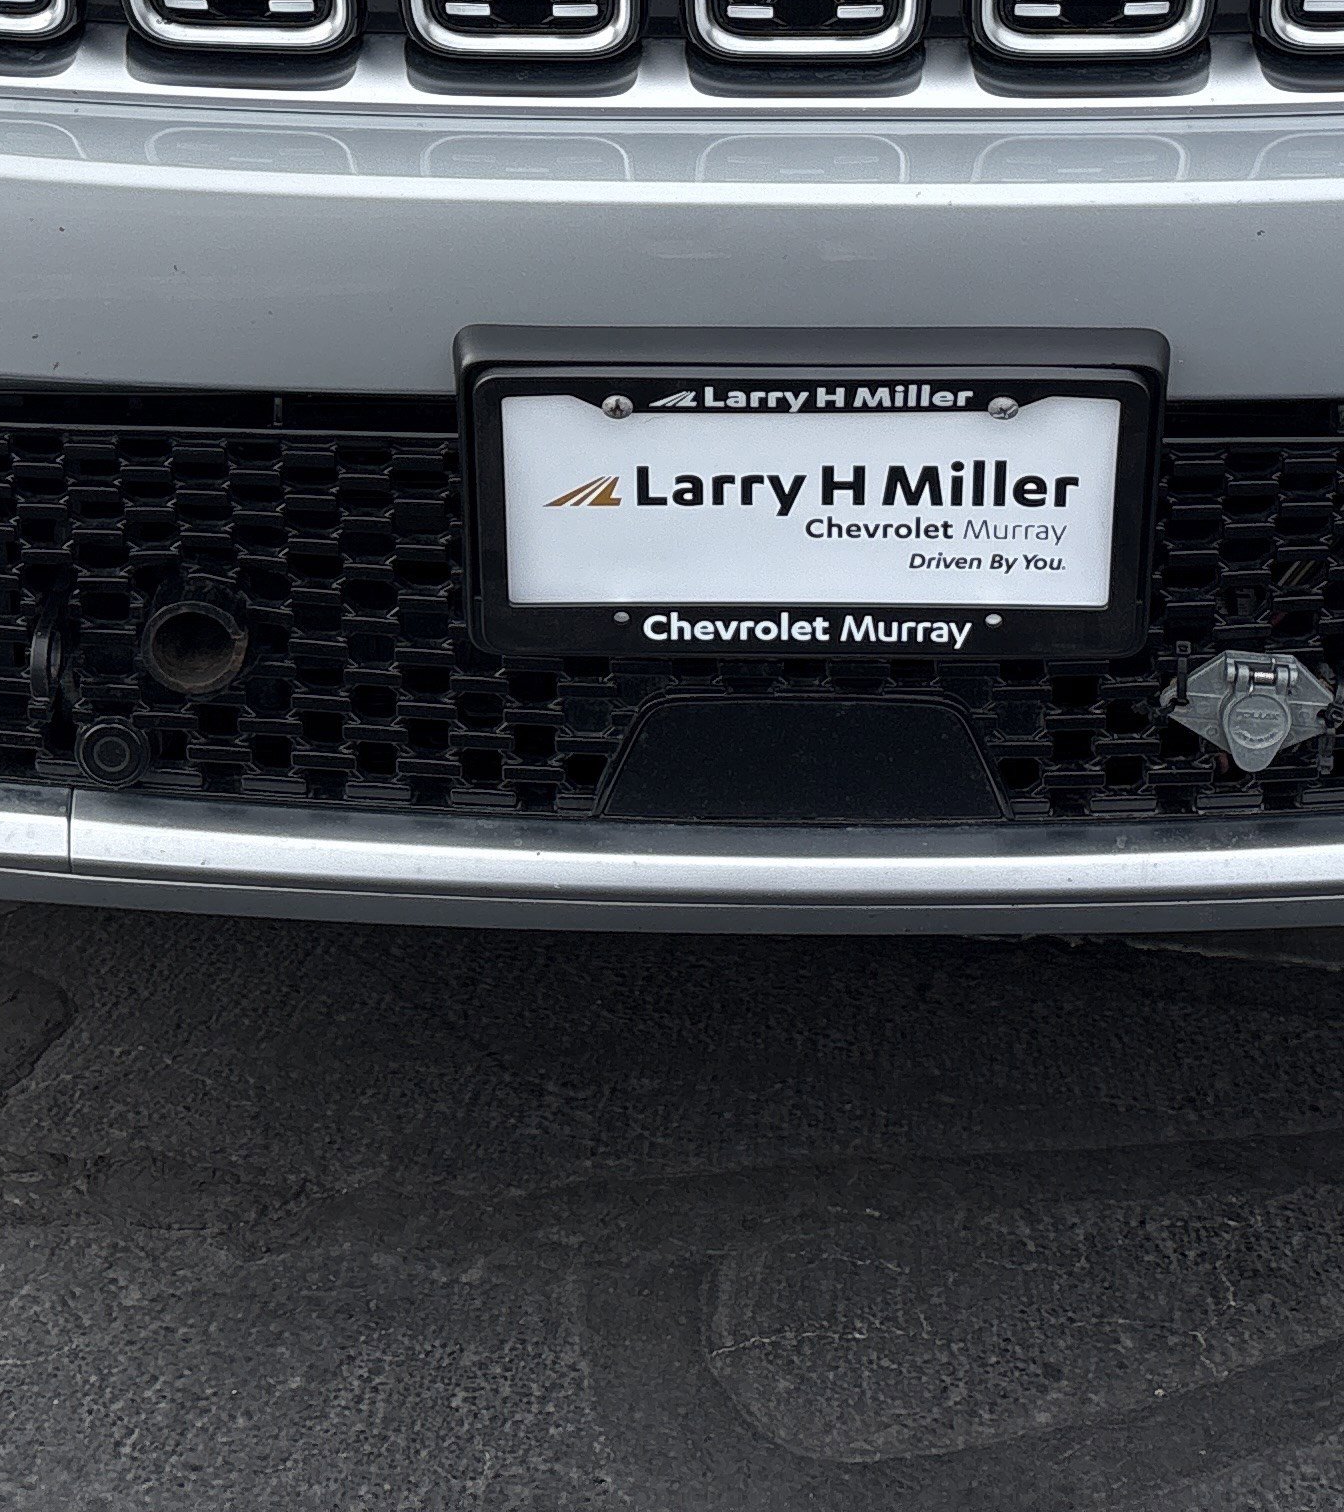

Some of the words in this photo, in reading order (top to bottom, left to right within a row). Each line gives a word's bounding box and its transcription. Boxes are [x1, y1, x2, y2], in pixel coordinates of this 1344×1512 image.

[704, 386, 809, 411] Larry
[817, 387, 846, 407] H
[853, 385, 973, 407] Miller
[636, 465, 806, 515] Larry
[823, 465, 865, 506] H
[882, 461, 1080, 508] Miller
[805, 518, 954, 540] Chevrolet
[963, 519, 1067, 544] Murray
[909, 552, 982, 569] Driven
[989, 554, 1018, 574] By
[643, 614, 829, 642] Chevrolet
[839, 614, 972, 648] Murray
